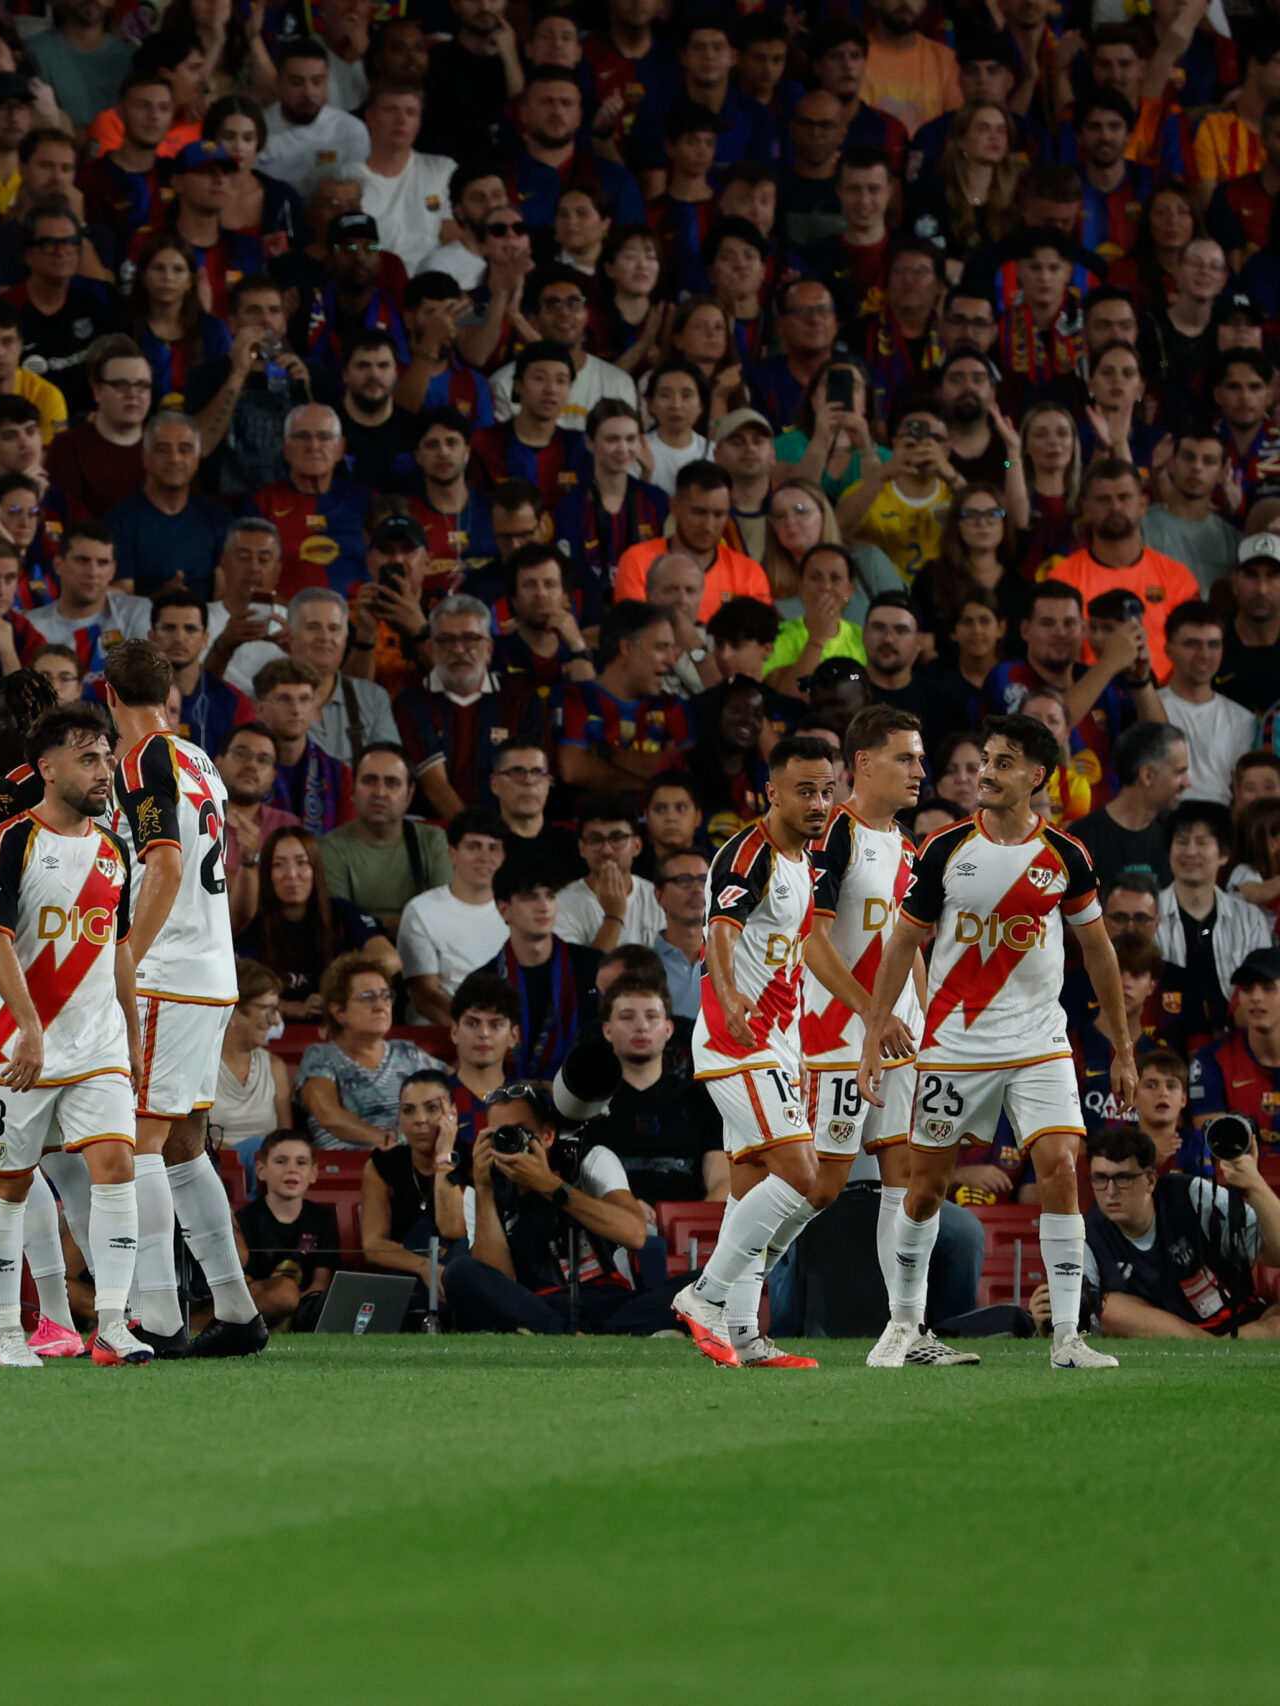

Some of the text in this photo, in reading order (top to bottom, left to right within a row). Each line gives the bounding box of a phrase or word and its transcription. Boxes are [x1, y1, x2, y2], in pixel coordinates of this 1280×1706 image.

[198, 798, 227, 896] 2
[955, 911, 1047, 950] DIGI
[831, 1077, 862, 1117] 19
[922, 1075, 964, 1117] 25
